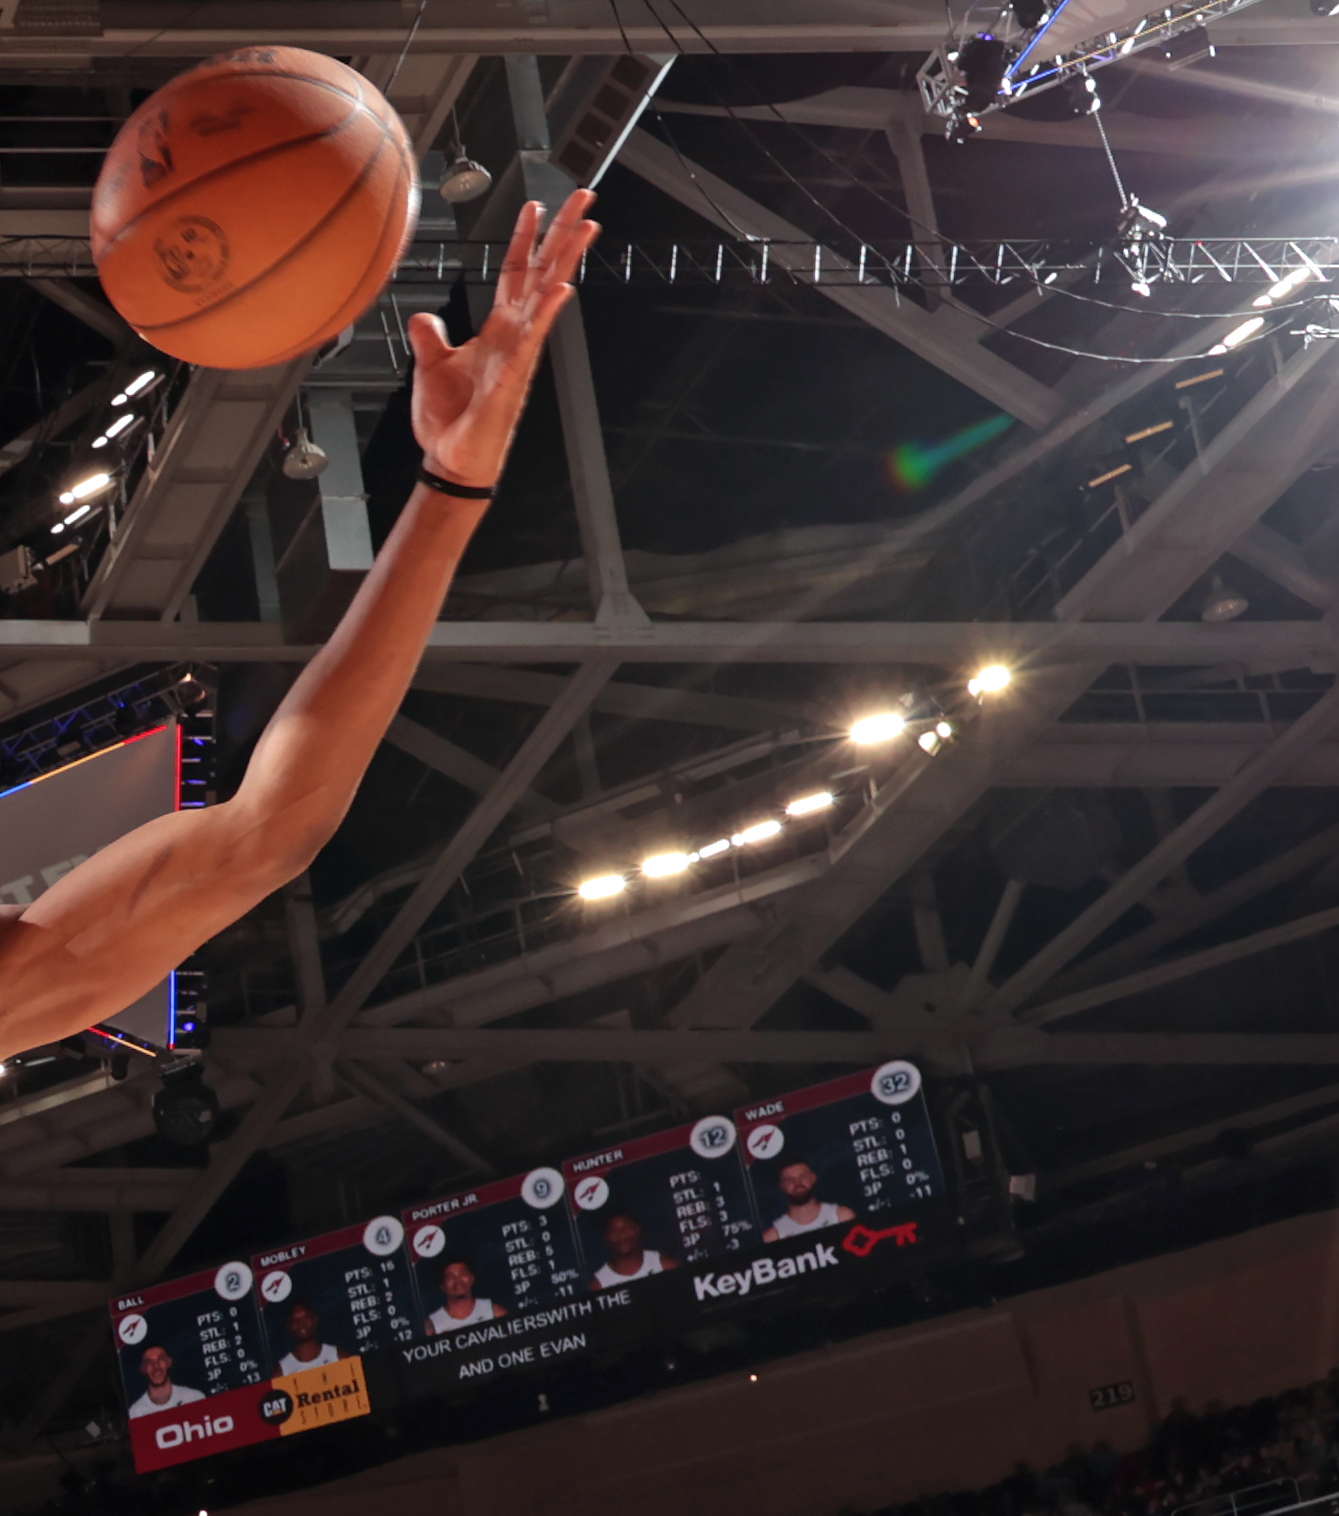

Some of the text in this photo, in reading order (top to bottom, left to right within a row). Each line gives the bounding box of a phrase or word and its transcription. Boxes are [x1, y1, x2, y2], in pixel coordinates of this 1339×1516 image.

[746, 1075, 908, 1121] WADE 32
[573, 1129, 725, 1173] HUNTER 12
[412, 1199, 460, 1220] PORTER
[535, 1180, 549, 1197] 9
[261, 1246, 306, 1267] MOBLEY
[694, 1242, 839, 1301] KeyBank
[118, 1273, 239, 1310] BALL 2
[403, 1336, 451, 1364] YOUR
[596, 1289, 631, 1309] THE
[459, 1333, 586, 1379] AND ONE EVAN
[263, 1399, 287, 1417] CAT
[296, 1380, 360, 1408] Rental
[156, 1415, 234, 1449] Ohio
